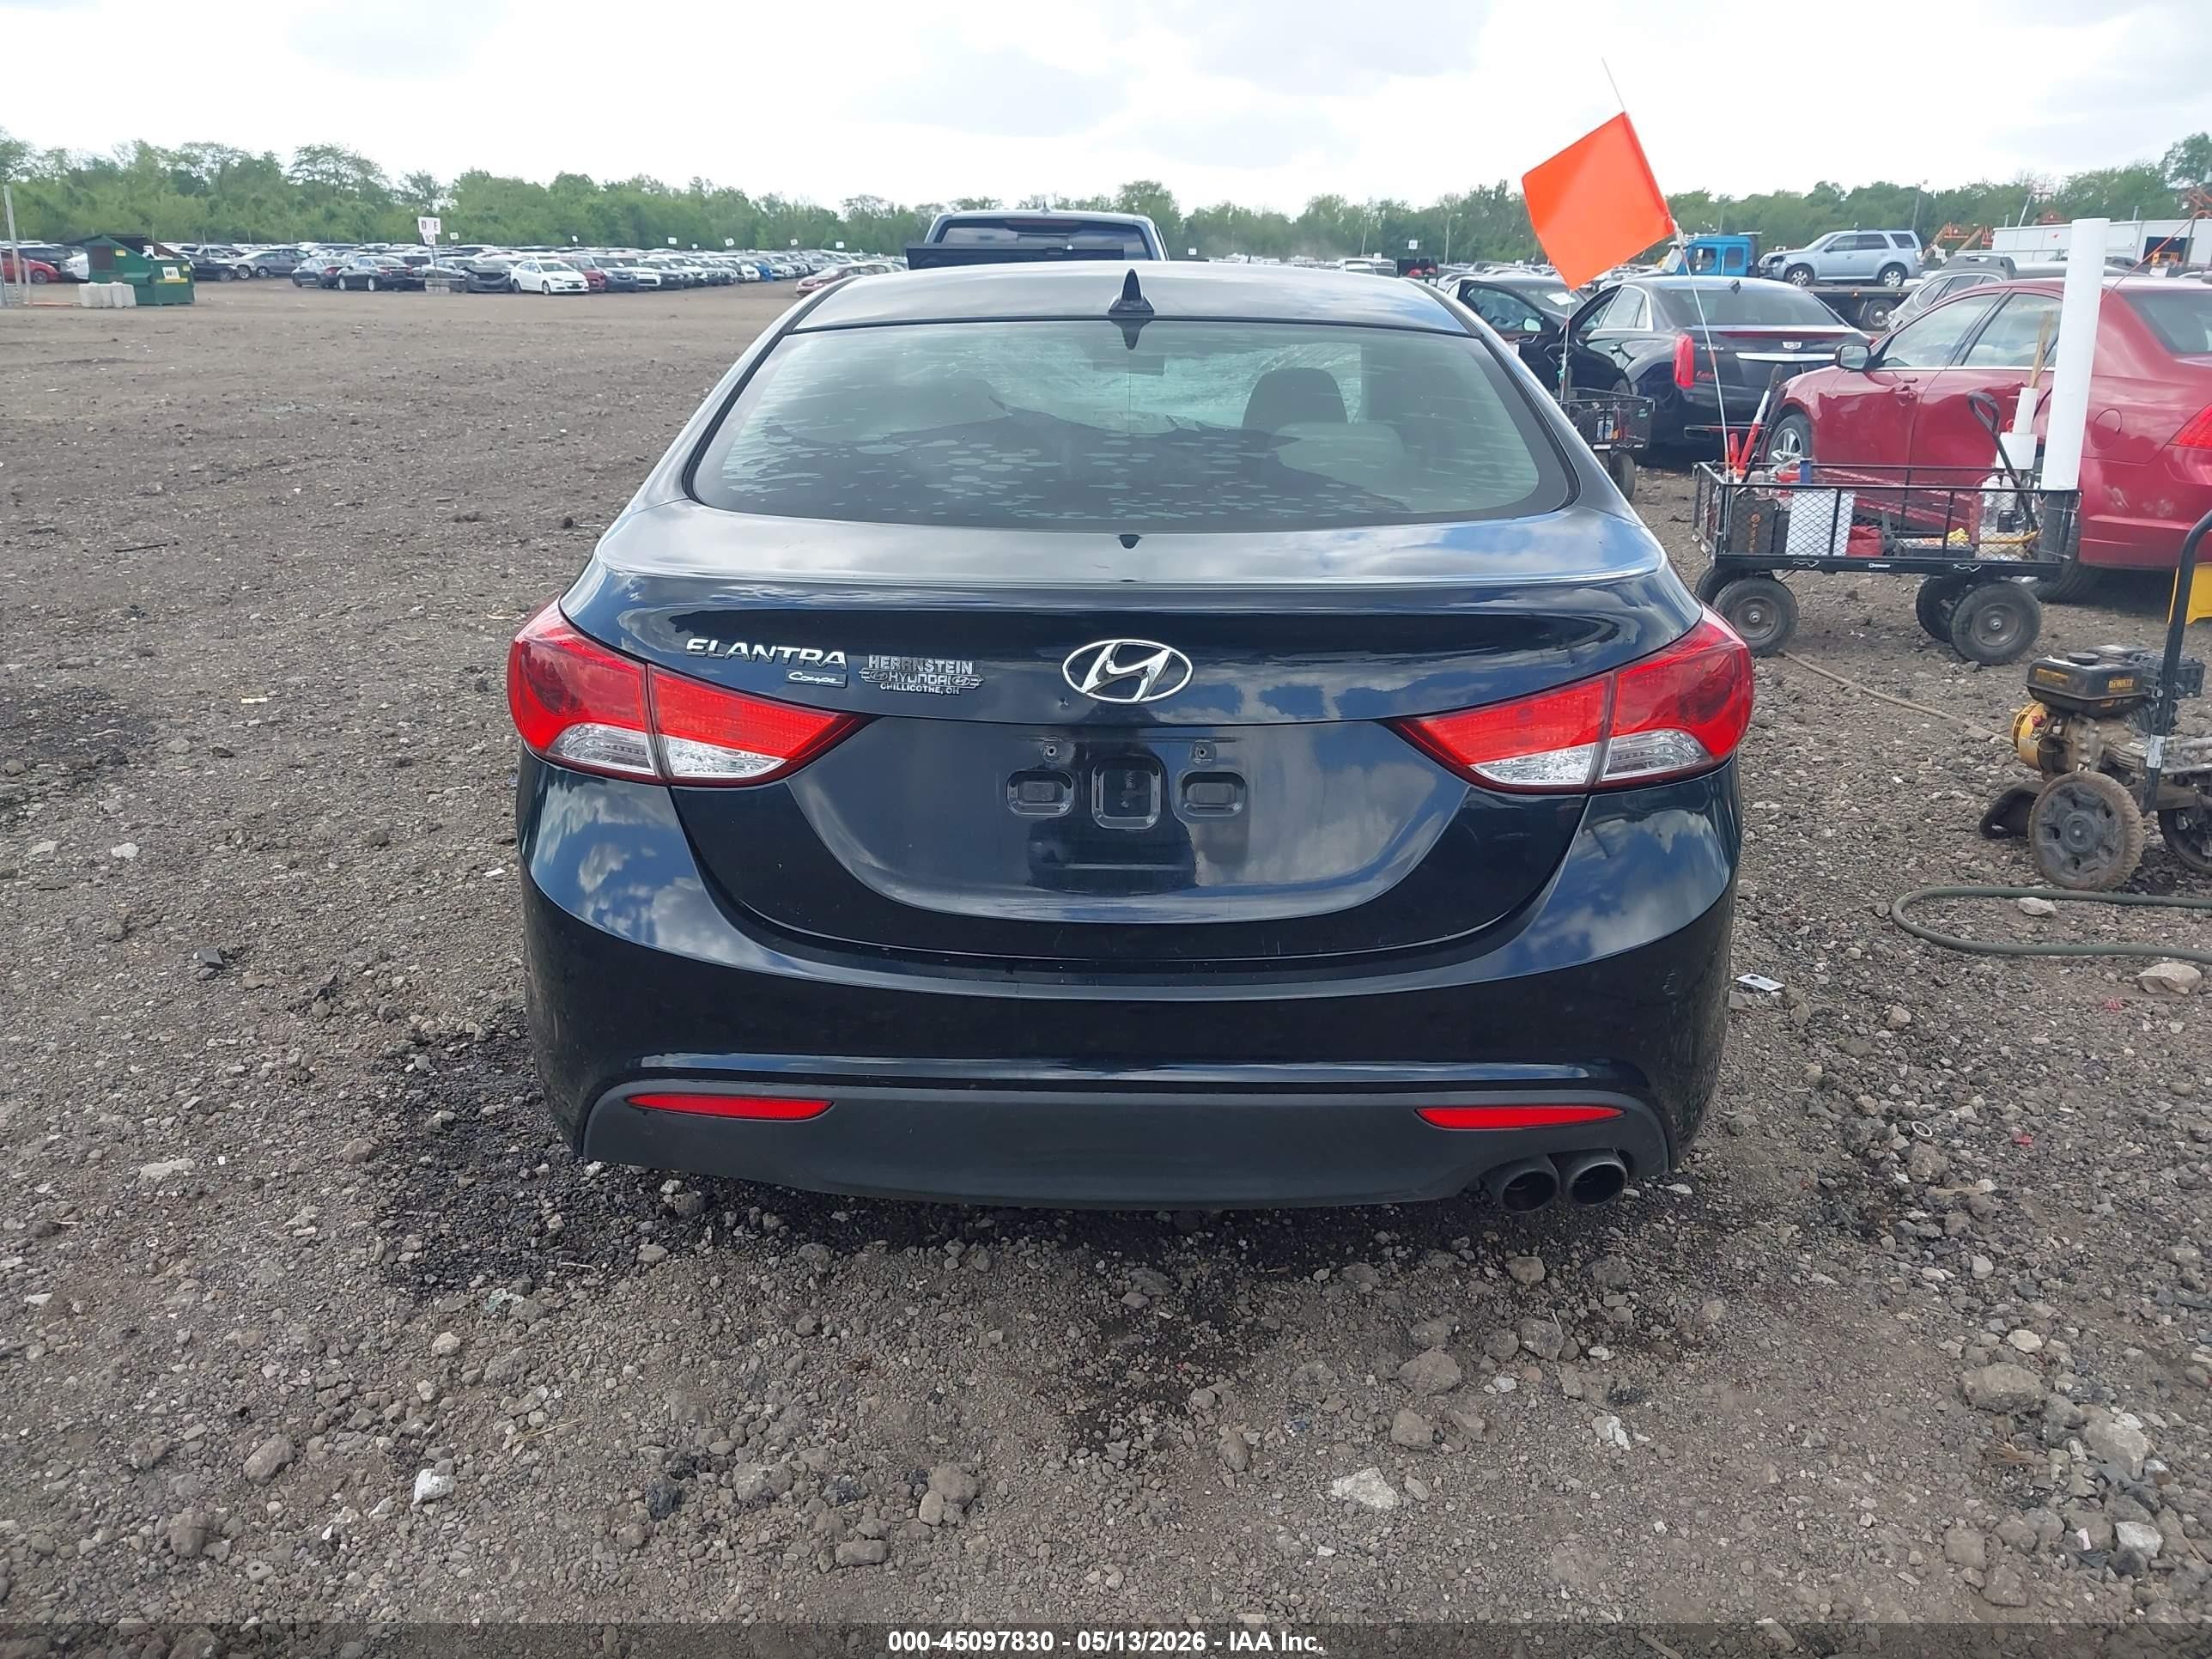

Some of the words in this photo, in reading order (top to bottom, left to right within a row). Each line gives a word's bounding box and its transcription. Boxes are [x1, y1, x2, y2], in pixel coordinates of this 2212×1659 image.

[686, 638, 848, 671] ELANTRA
[868, 654, 974, 675] HERRNSTEIN
[788, 672, 844, 685] Coupe
[888, 672, 951, 686] HYUNDAI
[880, 683, 945, 695] CHILLICOTHE,
[945, 686, 960, 695] OH
